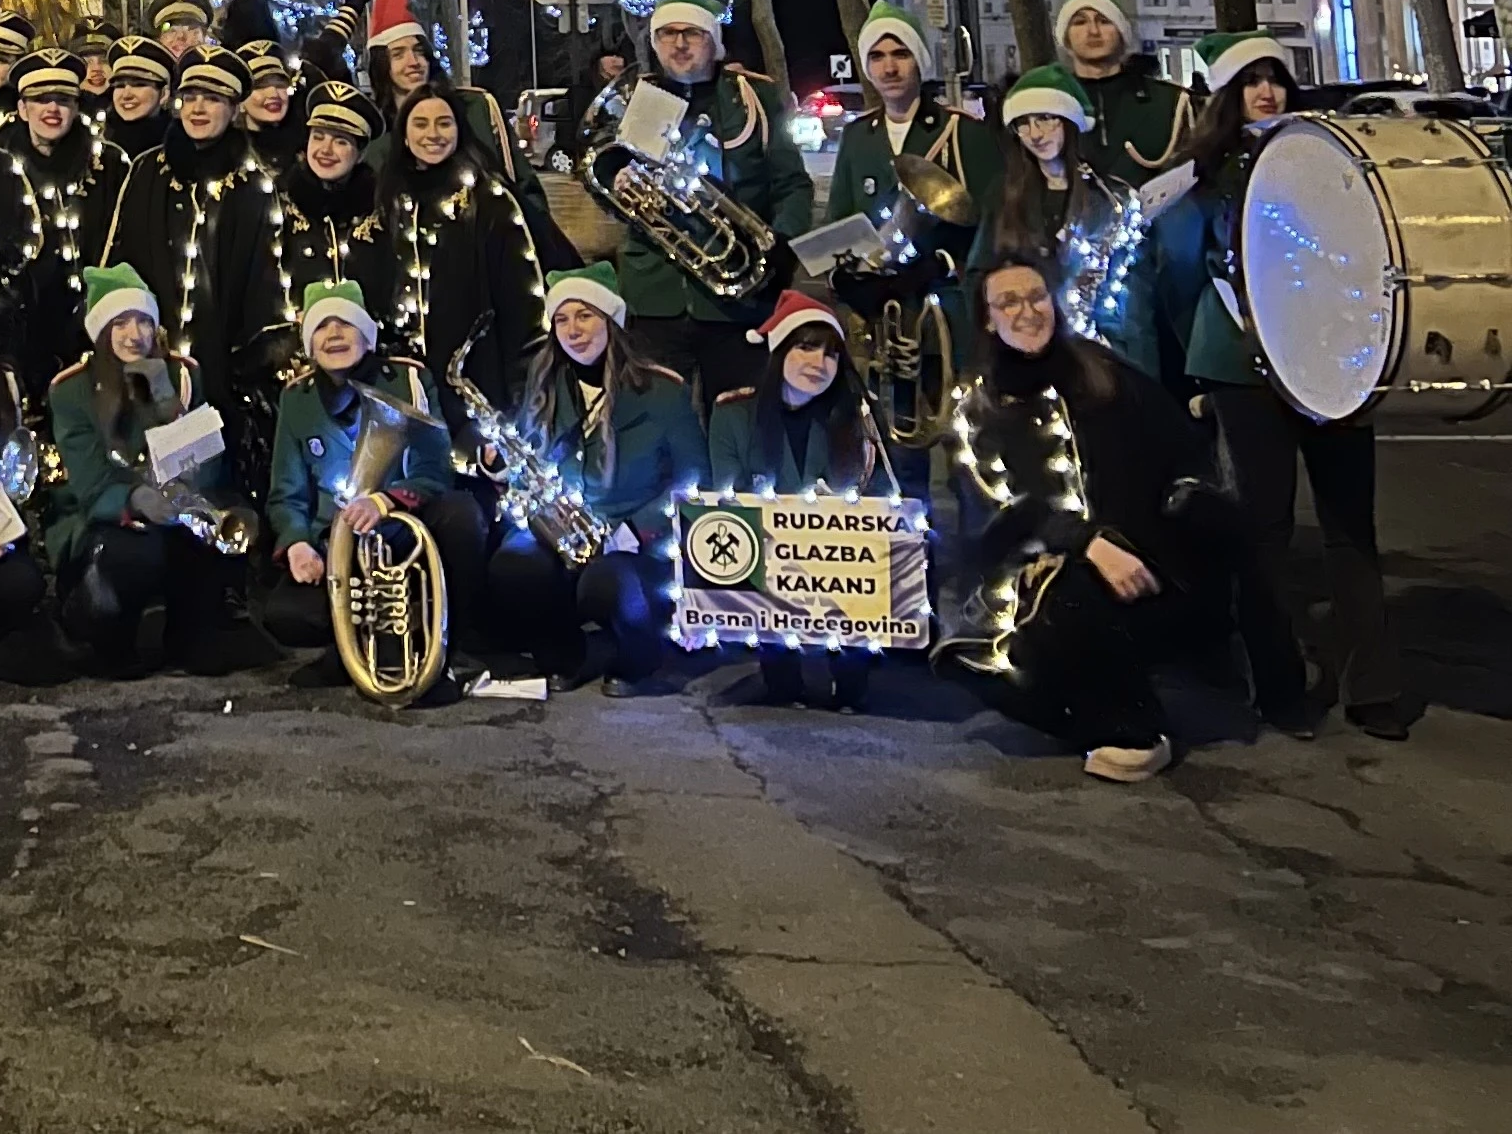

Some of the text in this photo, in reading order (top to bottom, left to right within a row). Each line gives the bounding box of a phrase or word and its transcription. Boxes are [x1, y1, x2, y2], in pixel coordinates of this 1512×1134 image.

[773, 512, 911, 533] RUDARSKA
[775, 544, 876, 563] GLAZBA
[776, 575, 876, 595] KAKANJ
[686, 610, 917, 635] Bosna i Hercegovina
